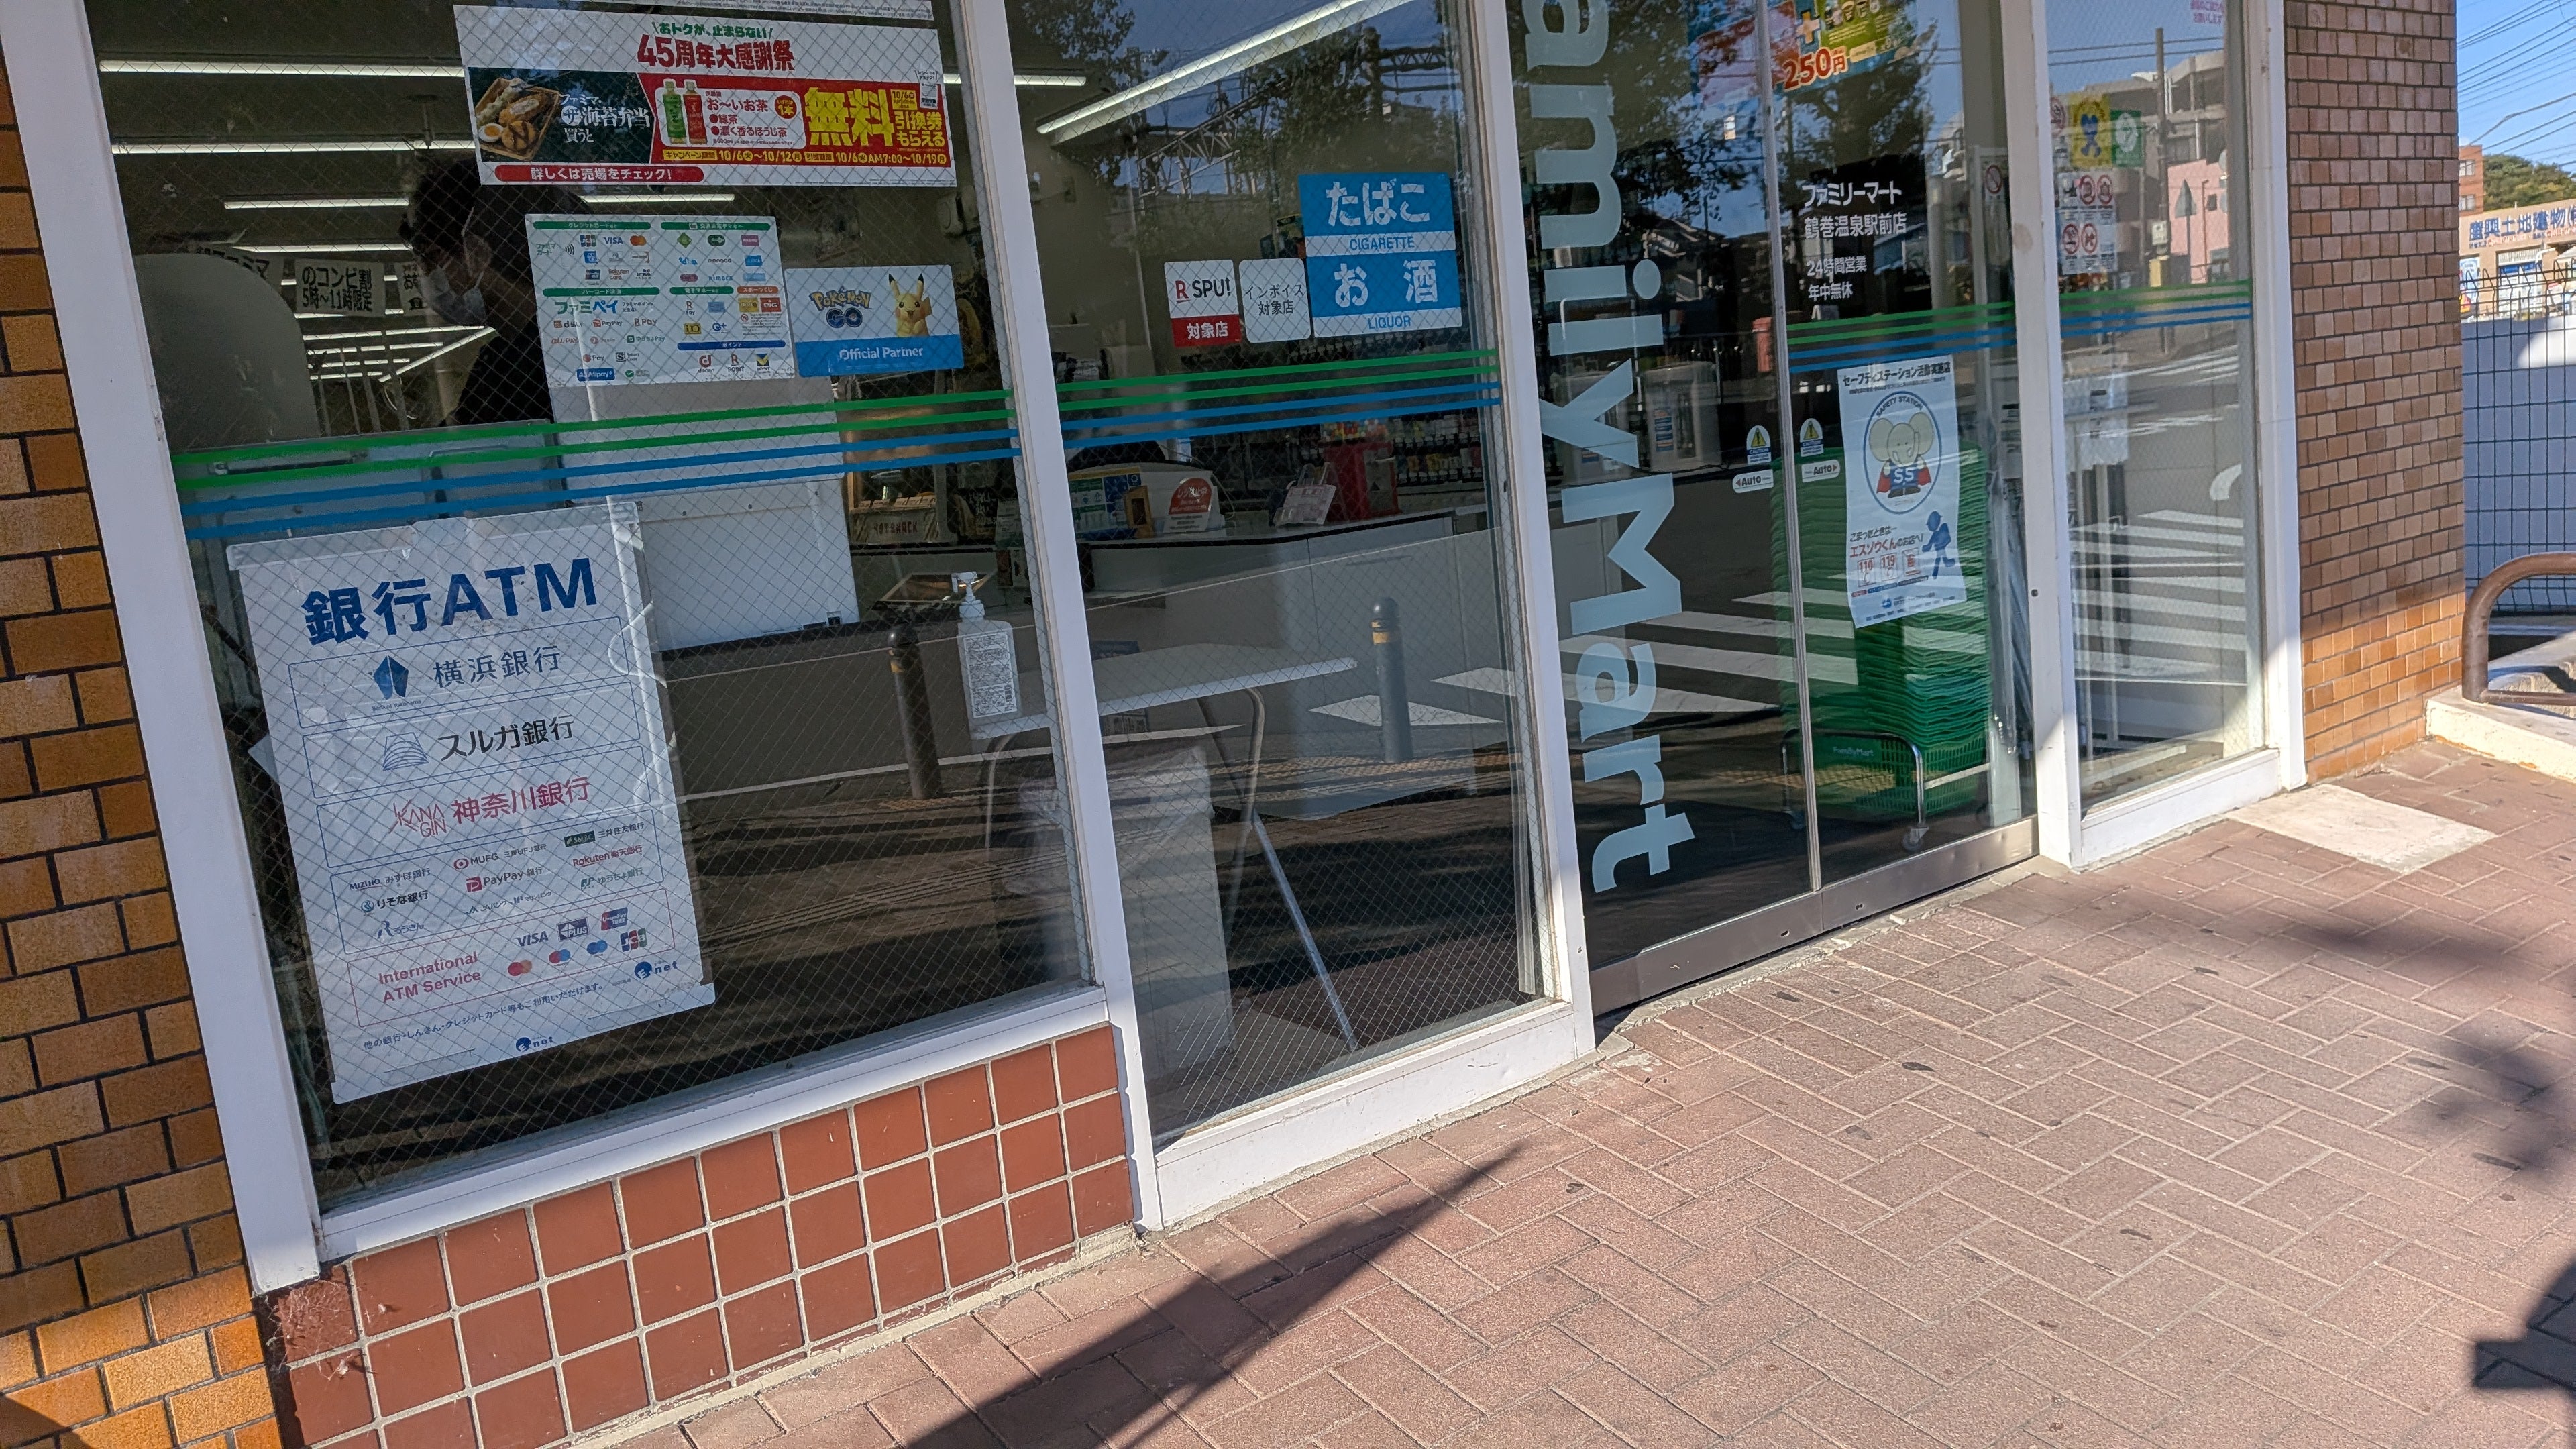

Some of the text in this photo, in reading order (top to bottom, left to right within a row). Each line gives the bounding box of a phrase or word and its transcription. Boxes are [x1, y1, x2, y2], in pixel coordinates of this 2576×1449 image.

[637, 34, 795, 70] 45周年大感謝祭
[805, 87, 894, 146] 無料
[894, 111, 943, 131] 引換券
[564, 128, 594, 144] 買うと
[896, 131, 945, 147] もらえる
[531, 166, 672, 180] 詳しくは売場をチェック!
[1326, 178, 1430, 226] たばこ
[1802, 180, 1902, 207] ファミリーマート
[1804, 212, 1907, 239] 鶴巻温泉駅前店
[1349, 235, 1415, 251] CIGARETTE
[1807, 255, 1867, 277] 24時間営業
[302, 265, 372, 291] のコンビ割
[1192, 277, 1231, 299] SPU!
[1245, 284, 1304, 301] インボイス
[1808, 281, 1854, 301] 年中無休
[555, 300, 618, 315] ファミペイ
[1258, 301, 1294, 316] 対象店
[1187, 322, 1228, 339] 対象店
[1368, 315, 1412, 329] LIQUOR
[839, 346, 923, 360] Official Partner
[1813, 464, 1833, 476] Auto
[1894, 468, 1915, 484] SS
[1741, 475, 1762, 486] Auto
[1858, 560, 1873, 572] 110
[1882, 555, 1896, 568] 119
[301, 557, 597, 647] 銀行ATM
[433, 645, 561, 688] 横浜銀行
[437, 714, 575, 761] スルガ銀行
[451, 777, 590, 824] 神奈川銀行
[420, 818, 447, 838] GIN
[598, 822, 645, 839] 三井住友銀行
[572, 832, 594, 844] SMBC
[504, 843, 547, 858] 三菱UFJ銀行
[470, 853, 500, 866] MUFG
[573, 852, 610, 867] Rakuten
[385, 867, 431, 885] みずほ銀行
[483, 870, 523, 887] PayPay
[527, 866, 543, 877] 銀行
[597, 867, 643, 885] ゆうちょ銀行
[350, 878, 380, 891] MIZUHO
[377, 890, 429, 909] りそな銀行
[517, 931, 549, 947] VISA
[568, 926, 588, 936] PLUS
[620, 928, 647, 953] JCB
[379, 951, 478, 985] International
[654, 961, 678, 973] net
[384, 972, 481, 1004] ATM Service
[532, 1036, 554, 1049] net
